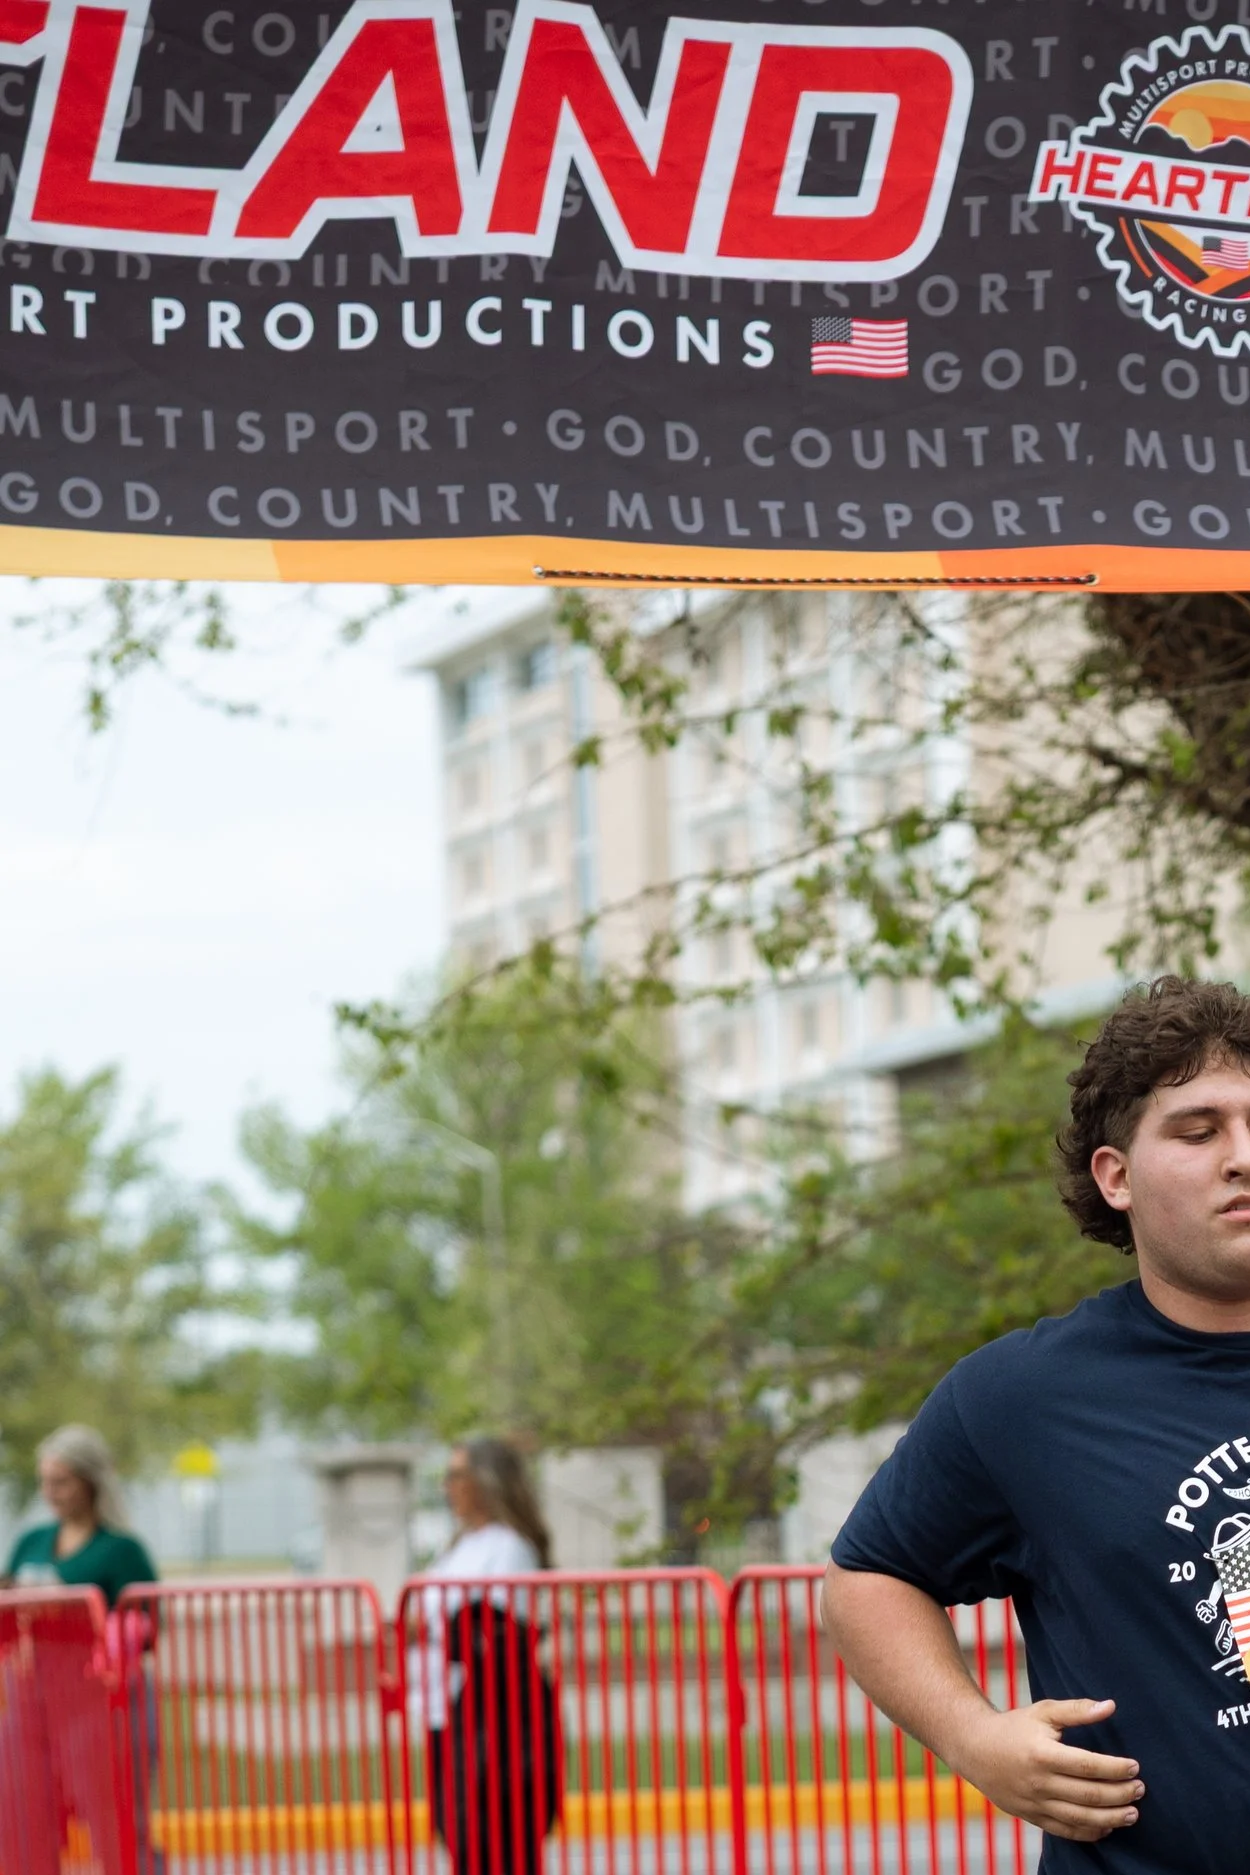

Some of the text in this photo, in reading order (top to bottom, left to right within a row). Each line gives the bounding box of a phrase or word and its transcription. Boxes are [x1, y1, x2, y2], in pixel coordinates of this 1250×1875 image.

[1118, 59, 1218, 139] MULTISPORT
[10, 284, 775, 369] RT PRODUCTIONS
[1153, 276, 1247, 323] RACING
[922, 346, 1088, 393] GOD,
[0, 394, 474, 455] MULTISPORT
[546, 408, 712, 467] GOD,
[743, 421, 1095, 471] COUNTRY,
[0, 470, 173, 527] GOD,
[207, 481, 574, 529] COUNTRY,
[606, 489, 1065, 540] MULTISPORT
[1168, 1560, 1196, 1583] 20
